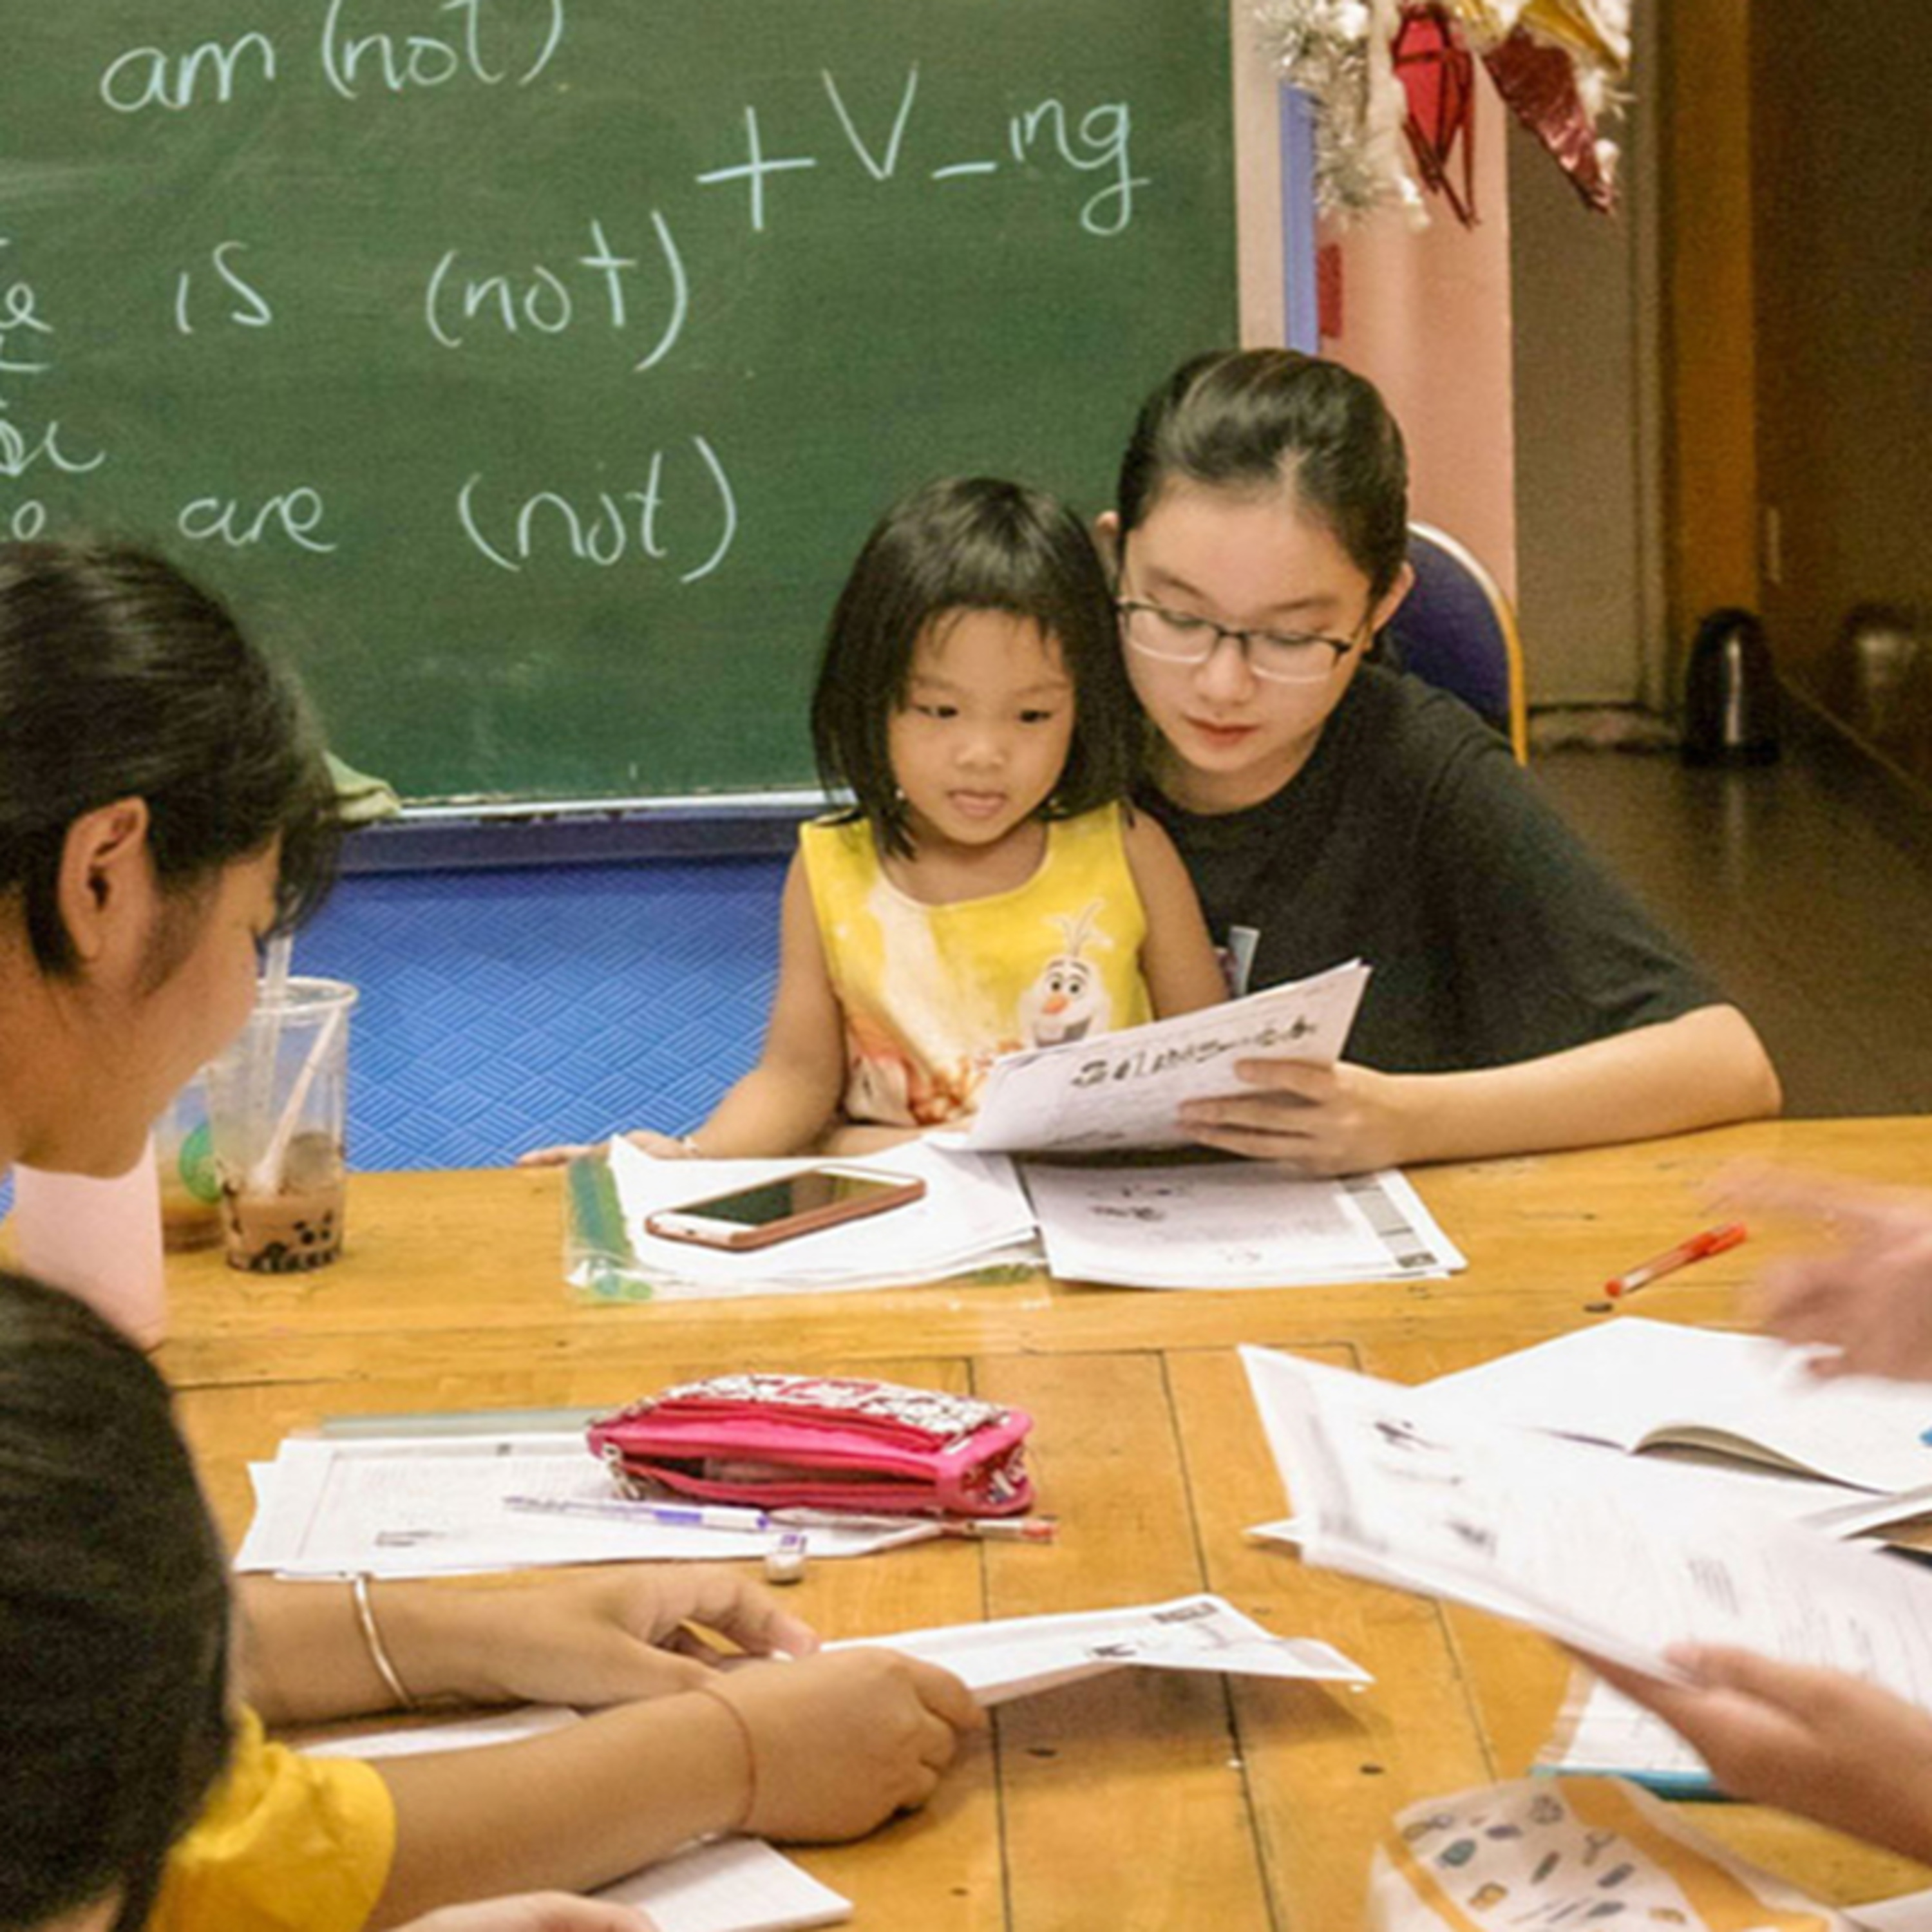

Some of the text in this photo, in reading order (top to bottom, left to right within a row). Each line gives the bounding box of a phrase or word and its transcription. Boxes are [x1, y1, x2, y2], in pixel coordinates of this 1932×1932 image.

[100, 31, 276, 111] am
[174, 242, 273, 334] is
[425, 209, 688, 372] (not)
[177, 435, 737, 583] are (not)
